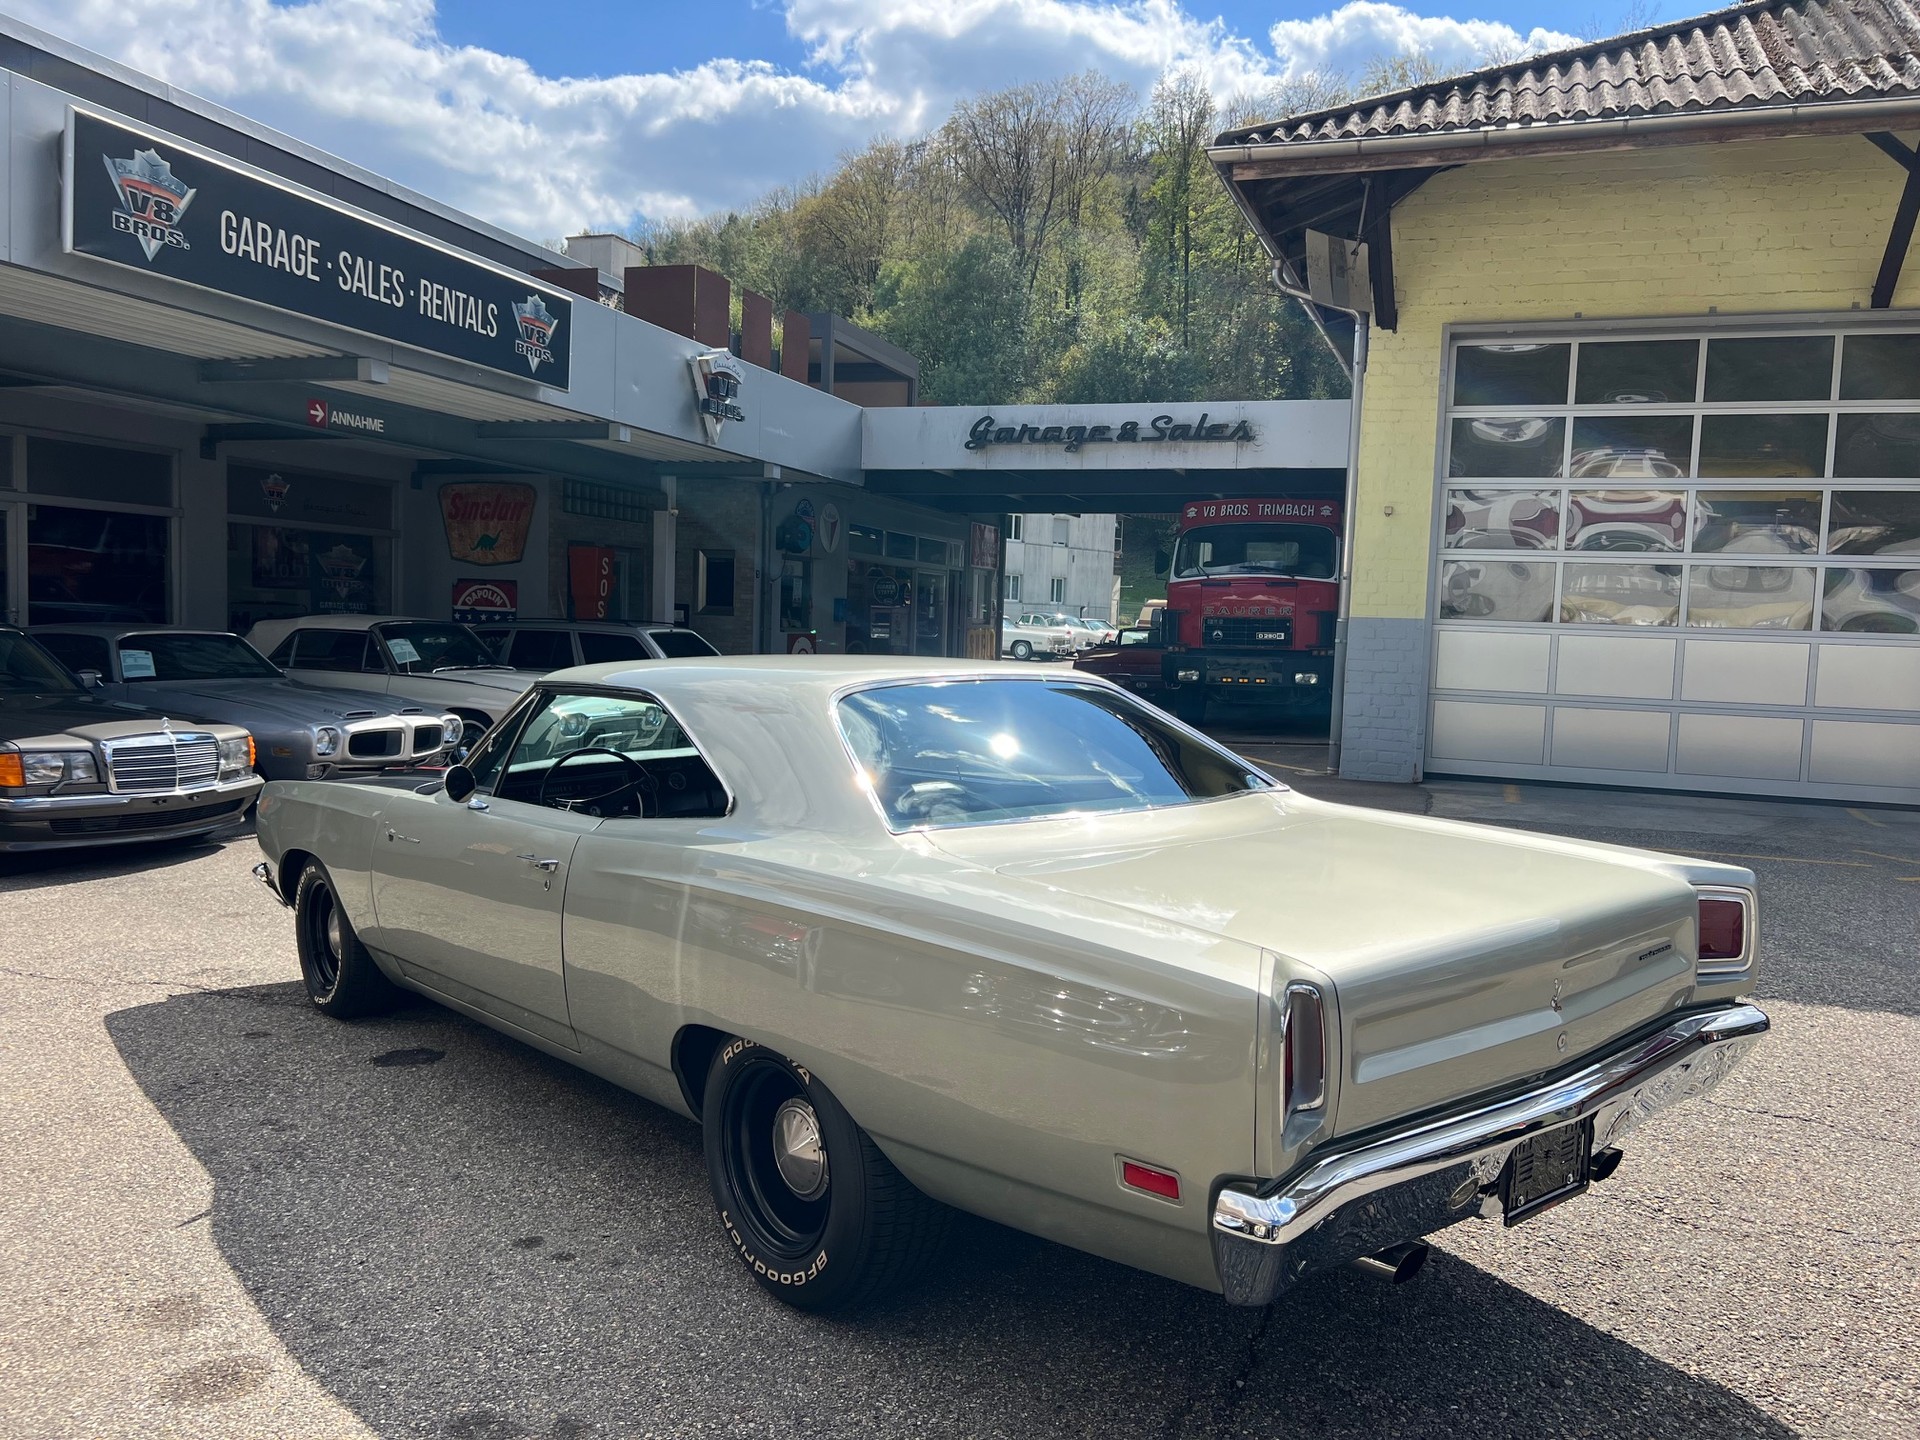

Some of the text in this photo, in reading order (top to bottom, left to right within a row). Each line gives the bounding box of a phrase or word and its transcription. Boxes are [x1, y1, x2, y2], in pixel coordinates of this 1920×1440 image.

[126, 187, 175, 225] V8
[220, 210, 498, 338] GARAGE SALES RENTALS
[523, 323, 549, 346] V8
[330, 410, 385, 433] ANNAHME
[964, 413, 1256, 452] Garage & Sales
[448, 492, 528, 521] Sinclair
[1203, 504, 1315, 517] V8 BROS. TRIMBACH
[464, 588, 504, 606] DAPOLIN
[596, 557, 609, 618] SOS
[1203, 606, 1292, 616] SAURER
[721, 1210, 829, 1286] BFGoodrich
